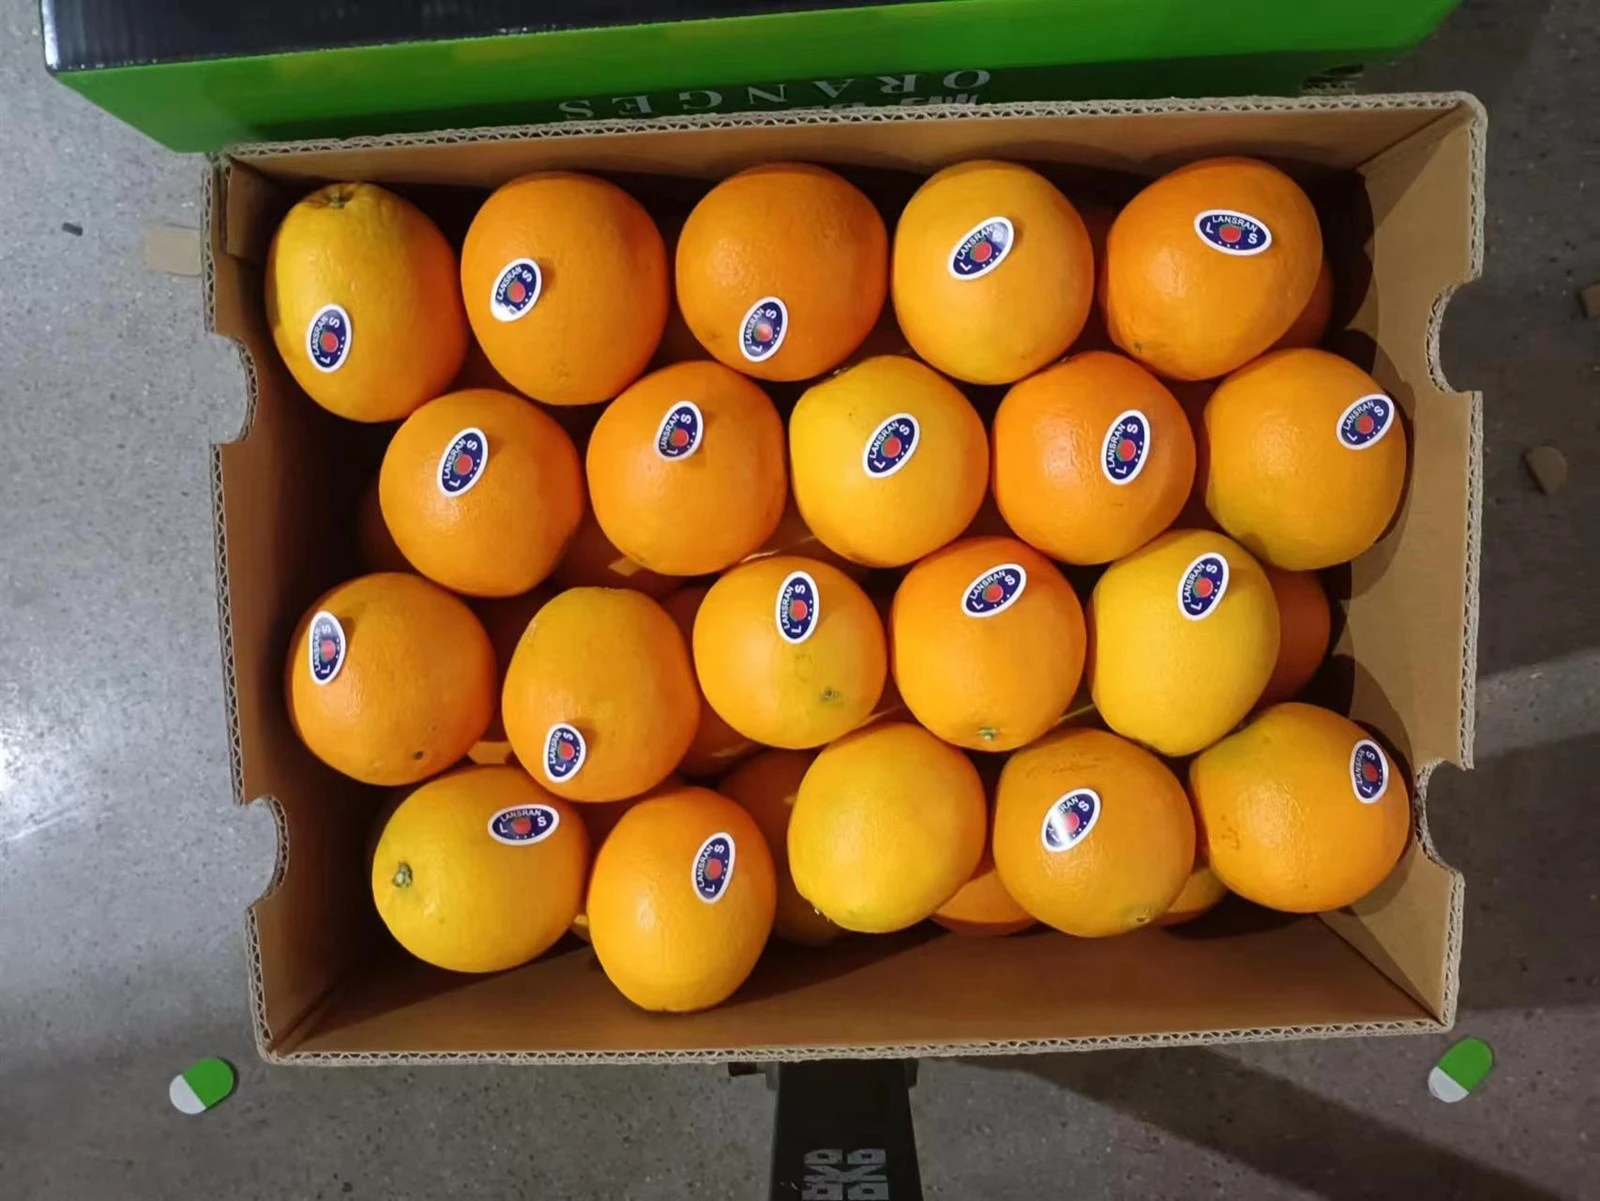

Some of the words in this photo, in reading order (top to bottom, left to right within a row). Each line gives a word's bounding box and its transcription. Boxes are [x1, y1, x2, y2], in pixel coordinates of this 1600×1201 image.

[557, 68, 991, 120] ORANGES
[1205, 222, 1213, 234] L
[1248, 232, 1258, 244] S
[1212, 216, 1258, 232] LANSRAN
[957, 226, 994, 260] LANSRAN
[497, 266, 522, 300] LANSRAN
[522, 271, 532, 282] S
[960, 262, 971, 271] L
[311, 316, 328, 355] LANSRAN
[320, 356, 330, 364] L
[329, 317, 340, 327] S
[746, 308, 764, 344] LANSRAN
[752, 344, 762, 352] L
[766, 308, 776, 319] S
[661, 413, 679, 449] LANSRAN
[680, 414, 692, 424] S
[1343, 401, 1374, 430] LANSRAN
[1347, 433, 1357, 441] L
[1374, 406, 1384, 416] S
[869, 421, 899, 458] LANSRAN
[874, 460, 885, 469] L
[899, 424, 910, 435] S
[1108, 424, 1125, 467] LANSRAN
[1115, 466, 1127, 474] L
[1127, 423, 1138, 433] S
[443, 439, 466, 479] LANSRAN
[449, 478, 460, 488] L
[467, 439, 477, 450] S
[795, 584, 805, 593] S
[970, 570, 1006, 600] LANSRAN
[972, 600, 983, 610] L
[1005, 575, 1015, 585] S
[1184, 563, 1205, 603] LANSRAN
[1191, 602, 1202, 610] L
[1206, 564, 1218, 574] S
[783, 586, 794, 629] LANSRAN
[321, 624, 331, 633] S
[791, 625, 801, 633] L
[321, 665, 330, 674] L
[555, 764, 566, 772] L
[562, 732, 574, 740] S
[1366, 751, 1375, 760] S
[1078, 801, 1089, 812] S
[1362, 785, 1373, 793] L
[499, 823, 508, 833] L
[537, 816, 546, 826] S
[501, 809, 541, 822] LANSRAN
[699, 845, 713, 887] LANSRAN
[705, 884, 715, 893] L
[714, 844, 725, 853] S
